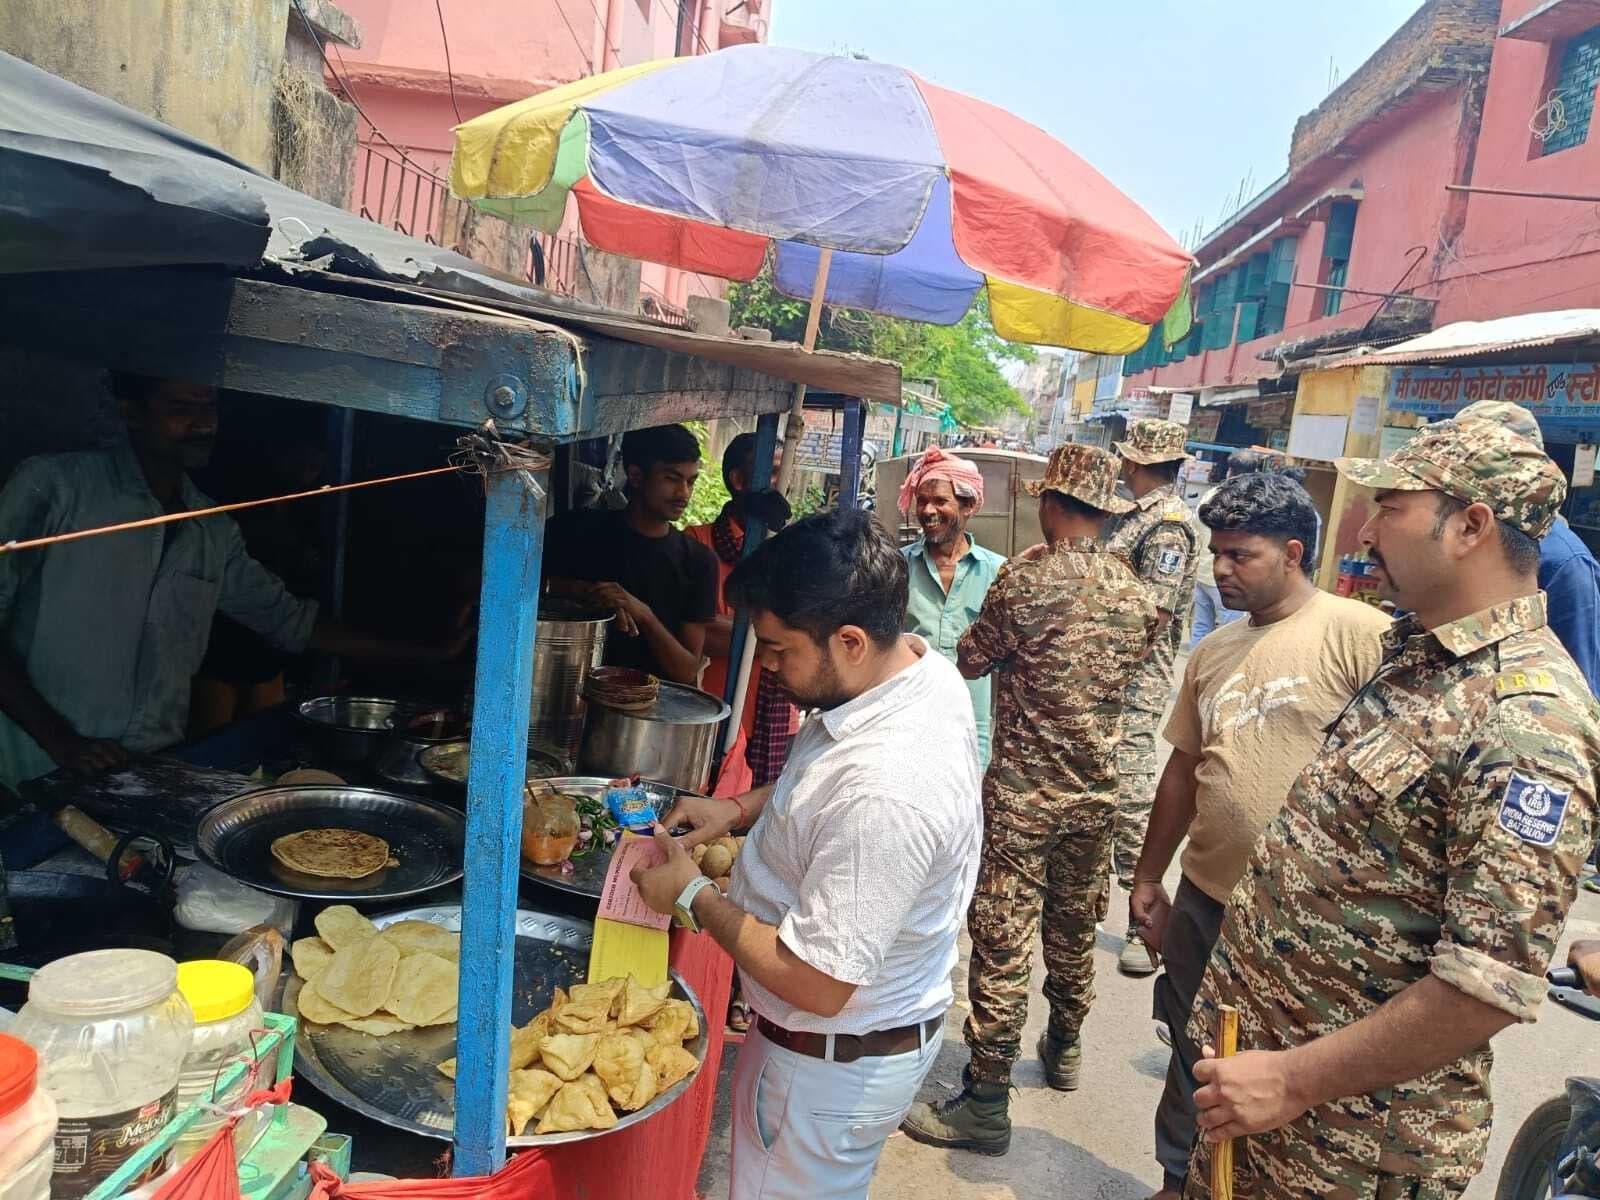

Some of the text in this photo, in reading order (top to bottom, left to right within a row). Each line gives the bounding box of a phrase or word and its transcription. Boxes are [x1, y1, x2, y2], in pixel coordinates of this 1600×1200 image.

[1502, 806, 1556, 834] INDIA RESERVE
[1506, 818, 1546, 841] BATTALION
[118, 1104, 171, 1145] Melody
